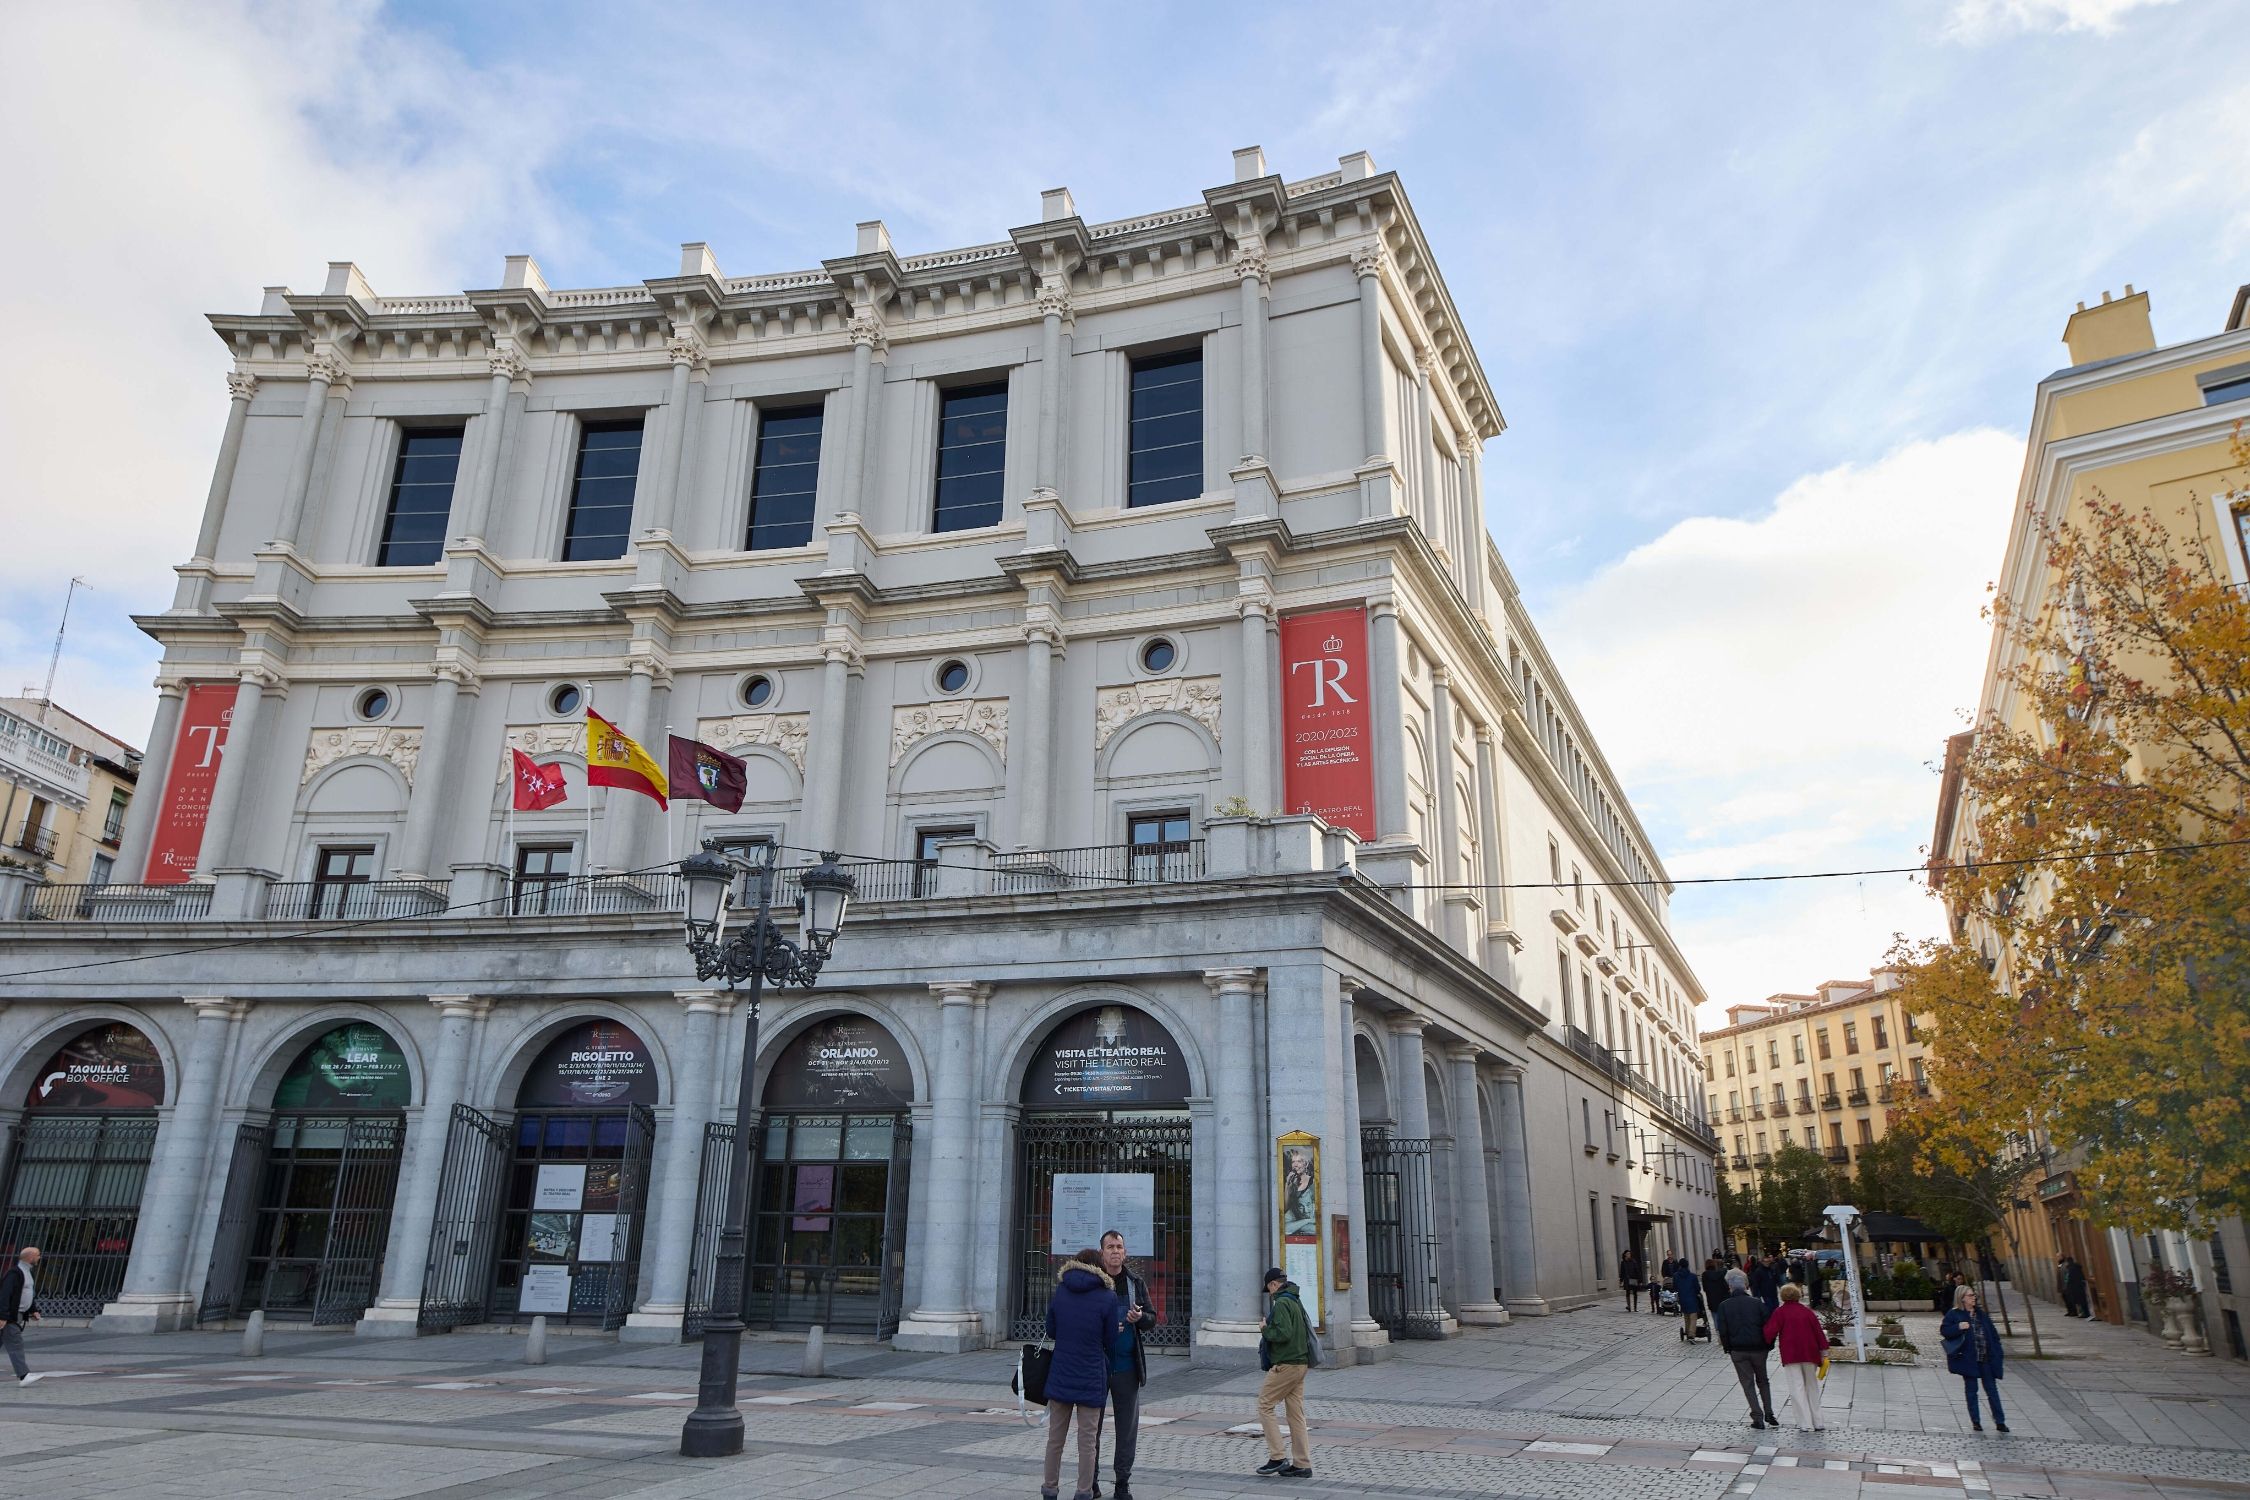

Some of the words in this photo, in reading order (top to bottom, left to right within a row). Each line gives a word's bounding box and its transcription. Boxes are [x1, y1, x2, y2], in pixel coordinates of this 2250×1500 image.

[1296, 727, 1358, 743] 2020/2023
[1325, 745, 1350, 753] DIFUSIÓN
[1330, 757, 1359, 765] ESCÉNICAS
[571, 1052, 634, 1062] RIGOLETTO
[821, 1048, 879, 1058] ORLANDO
[1055, 1049, 1086, 1058] VISITA
[1087, 1049, 1099, 1057] EL
[1100, 1047, 1139, 1057] TEATRO
[1140, 1047, 1167, 1056] REAL
[347, 1053, 378, 1063] LEAR
[1055, 1060, 1078, 1069] VISIT
[1080, 1060, 1098, 1068] THE
[1101, 1059, 1139, 1068] TEATRO
[1140, 1058, 1167, 1066] REAL
[69, 1065, 128, 1074] TAQUILLAS
[67, 1075, 89, 1083] BOX
[92, 1075, 130, 1083] OFFICE
